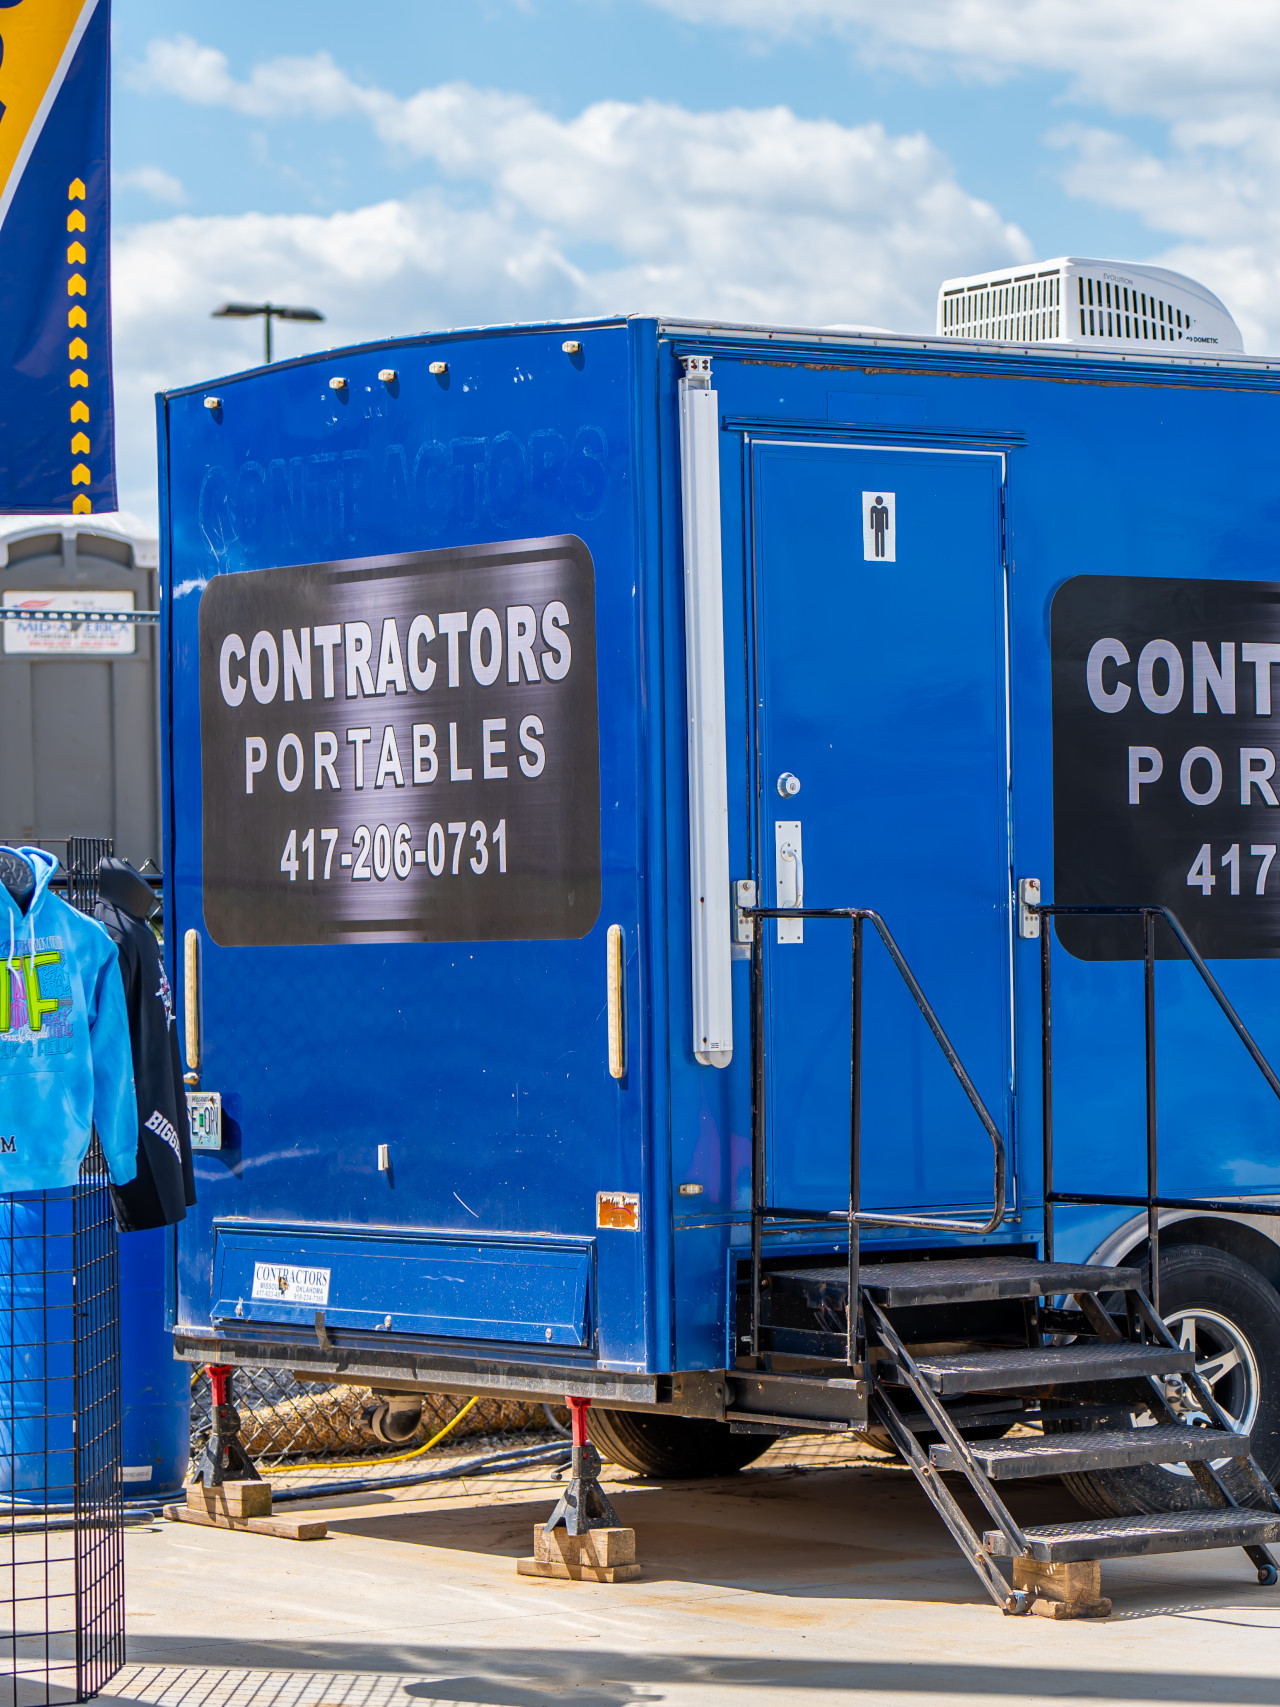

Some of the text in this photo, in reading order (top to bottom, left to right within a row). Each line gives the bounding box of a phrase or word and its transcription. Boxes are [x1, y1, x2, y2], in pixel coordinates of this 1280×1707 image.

[1103, 272, 1134, 286] EVOLUTION
[1194, 336, 1219, 344] DOMETIC
[218, 600, 573, 708] CONTRACTORS
[245, 714, 547, 794] PORTABLES
[280, 819, 508, 881] 417-206-0731
[256, 1265, 328, 1287] CONTRACTORS
[296, 1285, 323, 1294] OKLAHOMA
